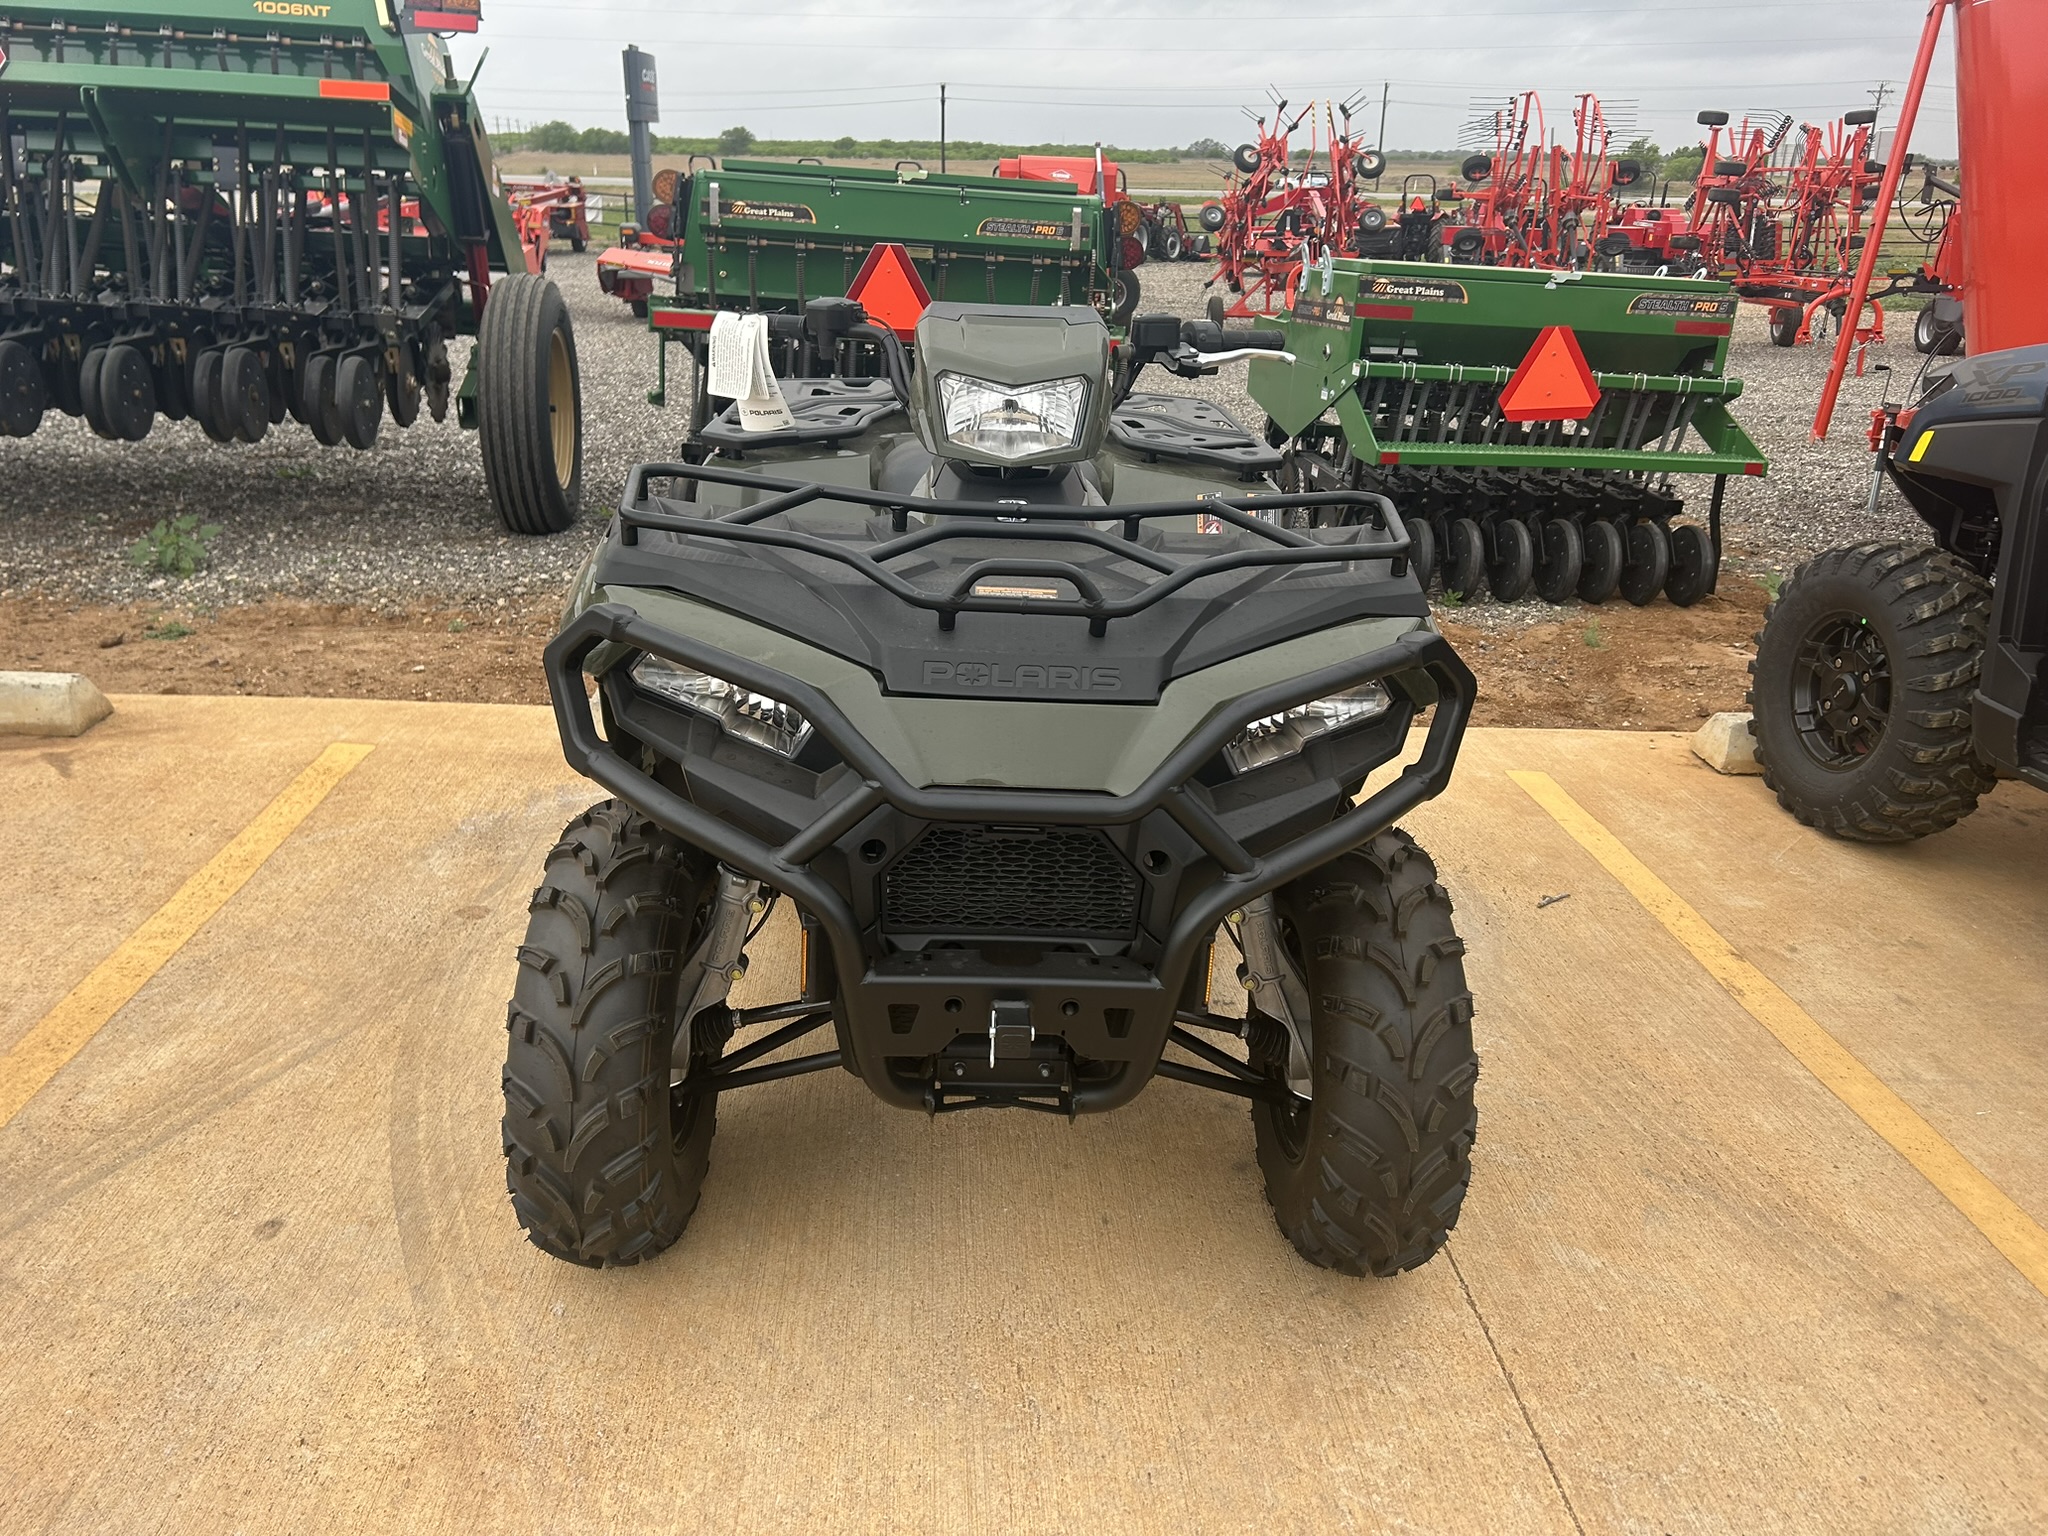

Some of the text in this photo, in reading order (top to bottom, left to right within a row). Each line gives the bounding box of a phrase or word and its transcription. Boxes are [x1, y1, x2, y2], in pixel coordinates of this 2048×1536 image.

[253, 1, 331, 17] 1006NT
[744, 207, 794, 217] Great Plains
[986, 222, 1031, 233] STEALTH
[1034, 225, 1056, 235] PRO
[1386, 285, 1444, 297] Great Plains
[1638, 299, 1690, 311] STEALTH
[1694, 301, 1718, 312] PRO
[1960, 361, 2046, 389] XP
[1961, 387, 2023, 403] 1000
[749, 408, 783, 417] POLARIS
[922, 659, 1122, 692] POLARIS
